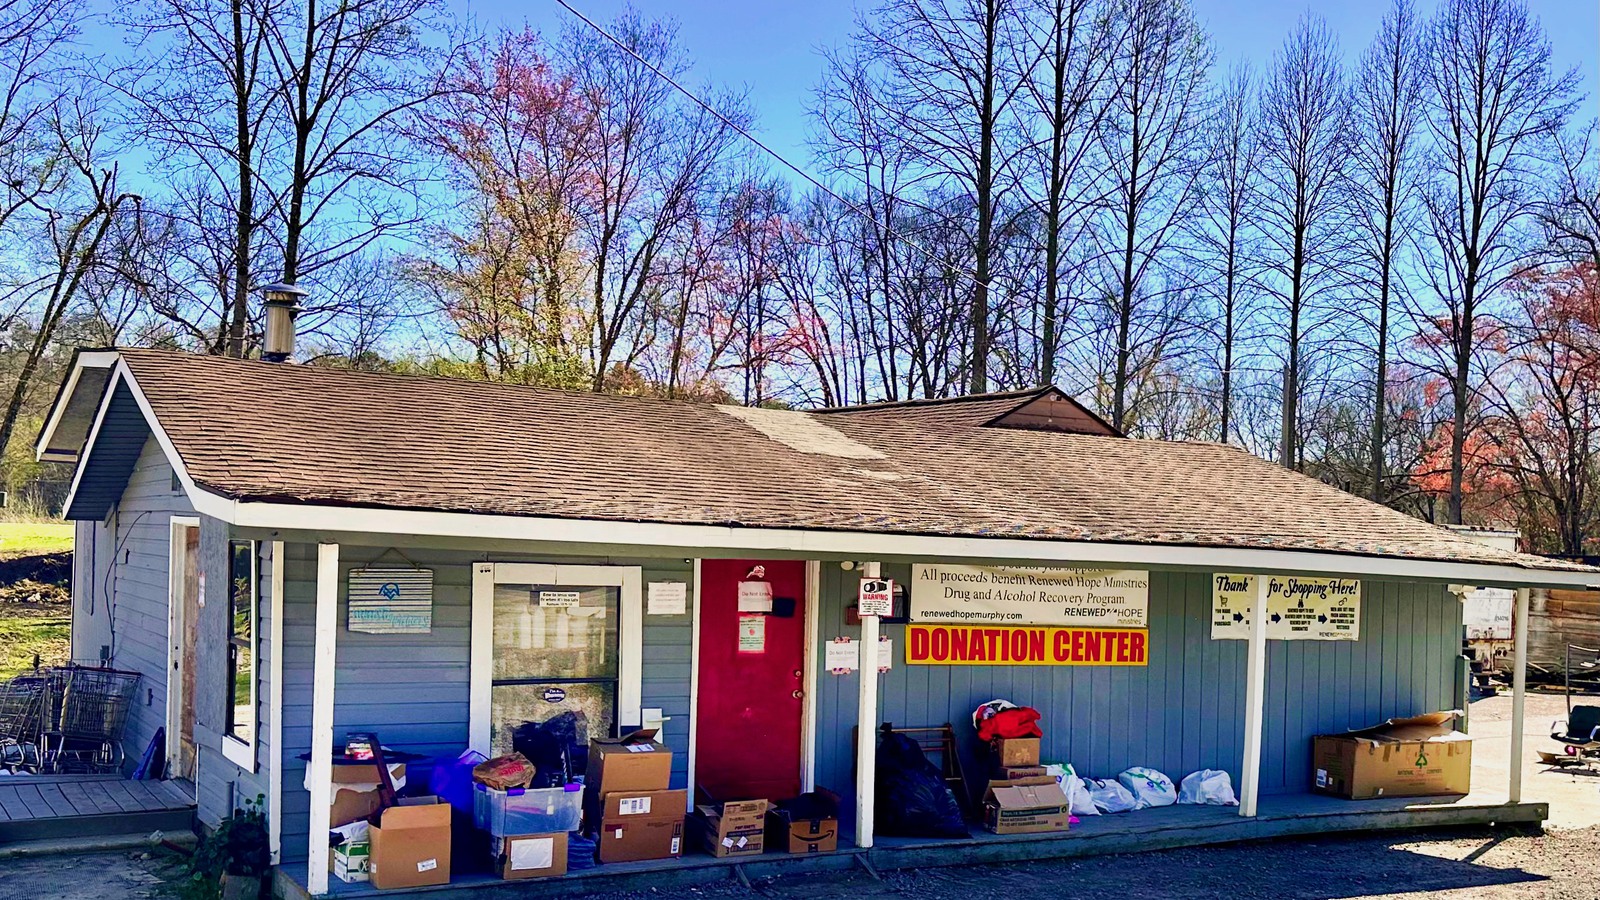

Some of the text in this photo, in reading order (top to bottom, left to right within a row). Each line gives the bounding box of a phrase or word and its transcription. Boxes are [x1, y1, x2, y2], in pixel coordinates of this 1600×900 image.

[920, 568, 1147, 590] All proceeds benefit Renewed Hope Ministries
[1216, 575, 1248, 592] Thank
[1266, 578, 1358, 599] for Shopping Here!
[863, 593, 888, 601] WARNING
[944, 586, 971, 602] Drug
[973, 588, 991, 600] and
[993, 589, 1036, 602] Alcohol
[1038, 591, 1084, 606] Recovery
[1064, 607, 1143, 618] RENEWED HOPE
[911, 628, 1145, 663] DONATION CENTER
